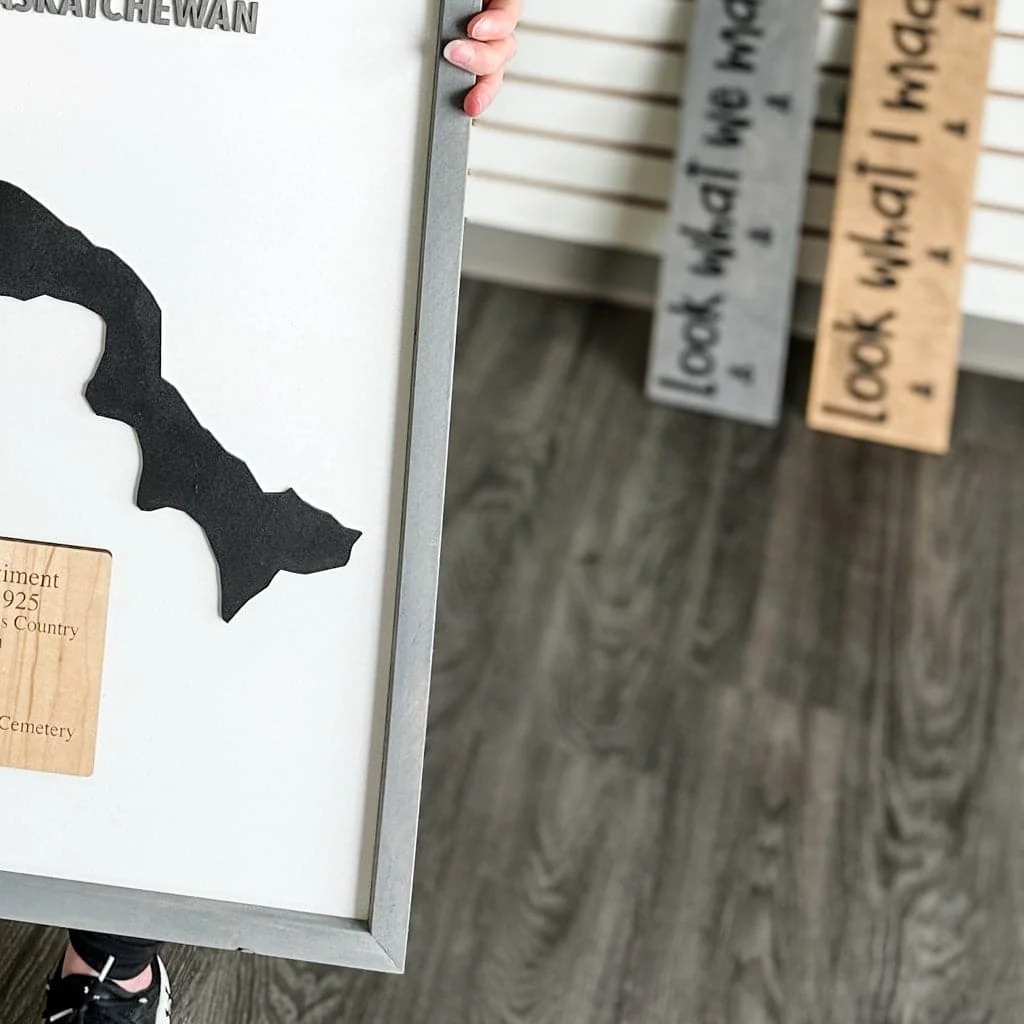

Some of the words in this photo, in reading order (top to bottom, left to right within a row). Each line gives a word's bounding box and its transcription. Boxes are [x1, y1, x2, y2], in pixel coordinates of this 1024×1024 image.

[708, 83, 749, 150] we
[679, 158, 744, 278] what
[849, 158, 919, 291] what
[658, 292, 724, 396] look
[822, 309, 895, 425] look
[13, 615, 80, 640] Country
